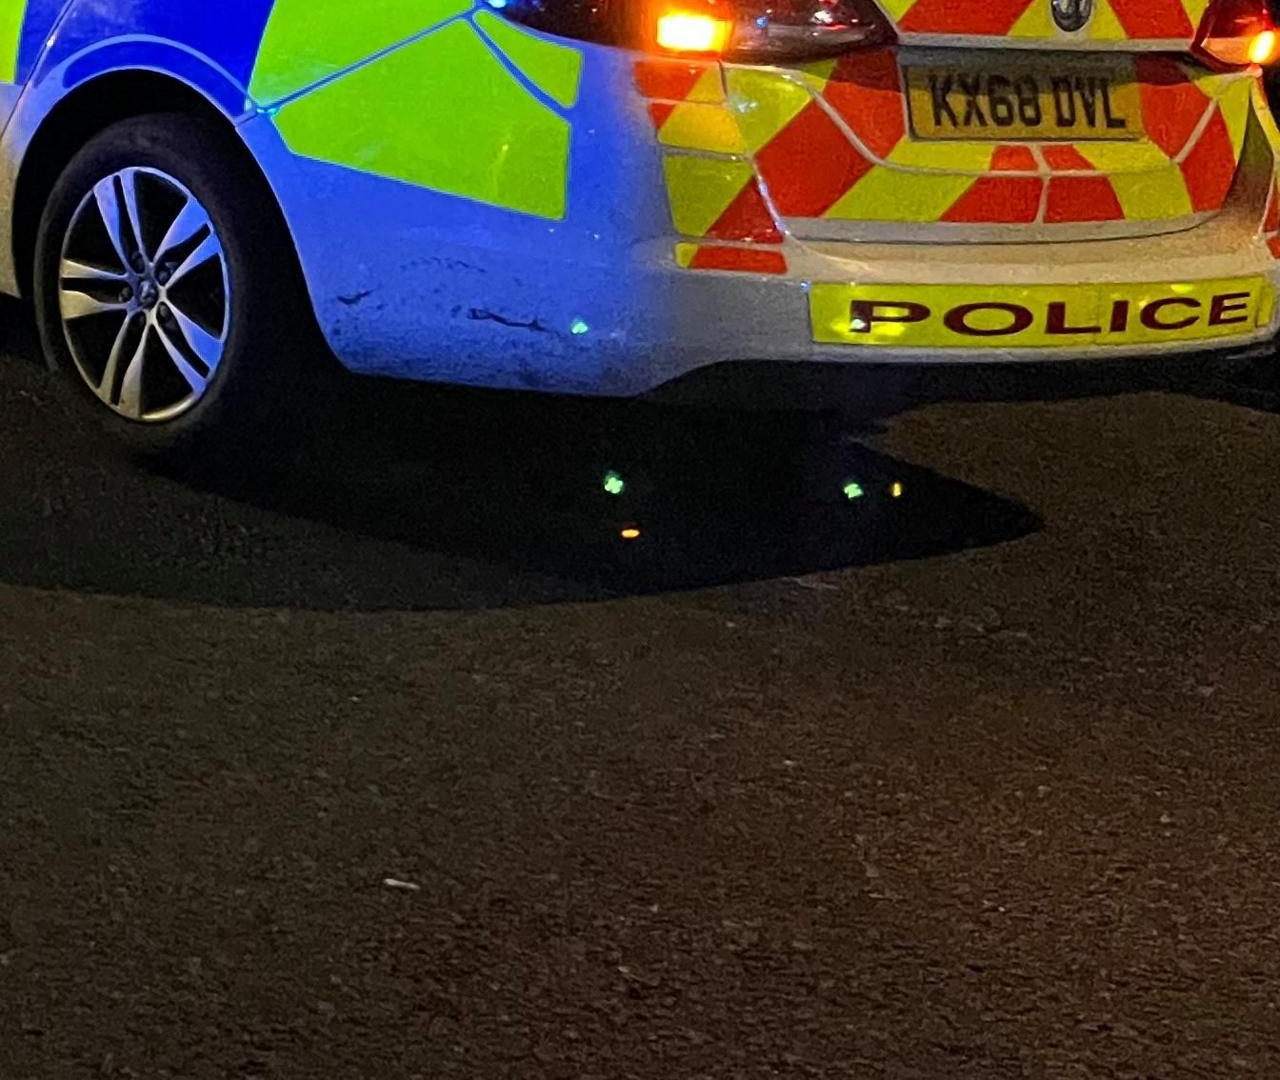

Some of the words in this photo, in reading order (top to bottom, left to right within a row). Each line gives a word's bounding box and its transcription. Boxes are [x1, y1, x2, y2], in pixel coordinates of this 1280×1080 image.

[928, 73, 1041, 128] KX68
[1051, 75, 1127, 129] DVL
[849, 292, 1251, 337] POLICE
